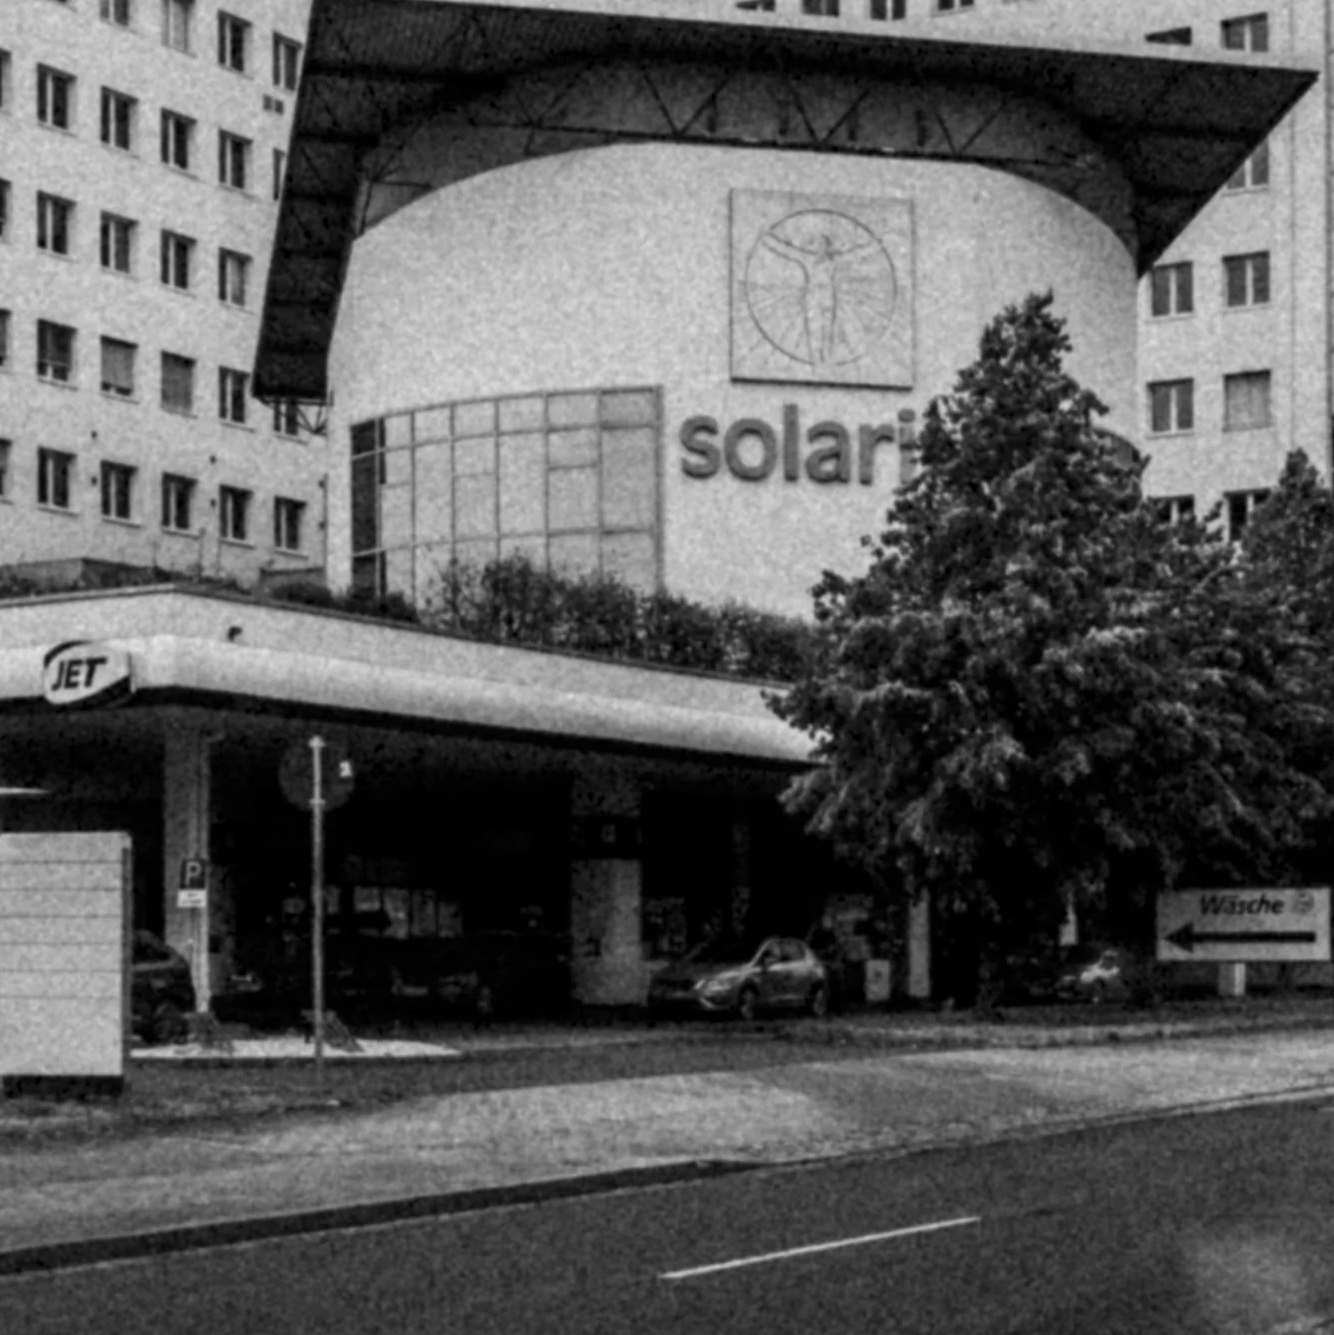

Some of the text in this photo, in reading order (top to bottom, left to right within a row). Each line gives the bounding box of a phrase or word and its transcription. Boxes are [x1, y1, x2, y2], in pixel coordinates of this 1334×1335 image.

[679, 403, 919, 485] solari
[51, 656, 108, 691] JET
[185, 861, 202, 886] P
[1200, 893, 1286, 916] Wäsche
